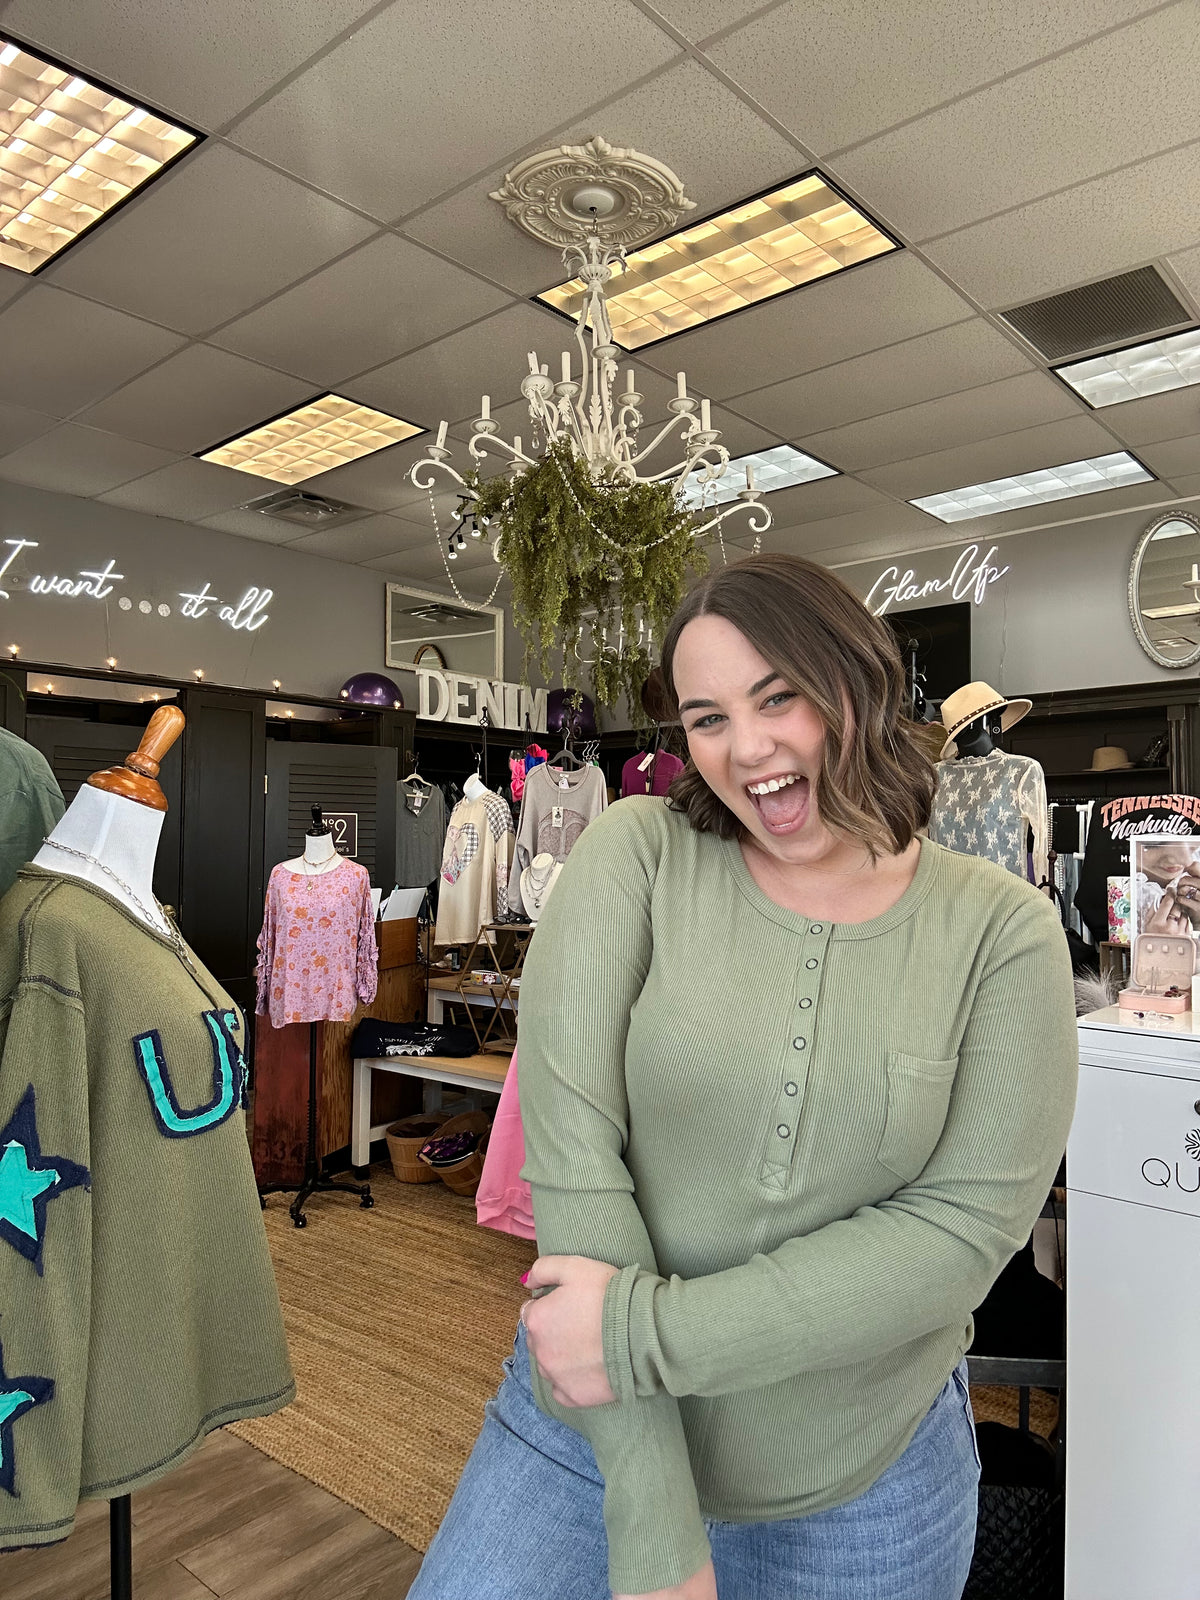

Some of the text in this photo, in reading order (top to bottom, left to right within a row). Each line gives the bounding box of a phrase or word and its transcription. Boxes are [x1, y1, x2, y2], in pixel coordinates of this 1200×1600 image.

[30, 559, 124, 599] want
[178, 582, 218, 619] it
[218, 586, 273, 631] all
[864, 544, 1010, 617] Glam Up
[415, 668, 550, 734] DENIM
[1100, 793, 1200, 828] TENNESSEE
[1109, 814, 1192, 840] Nashville
